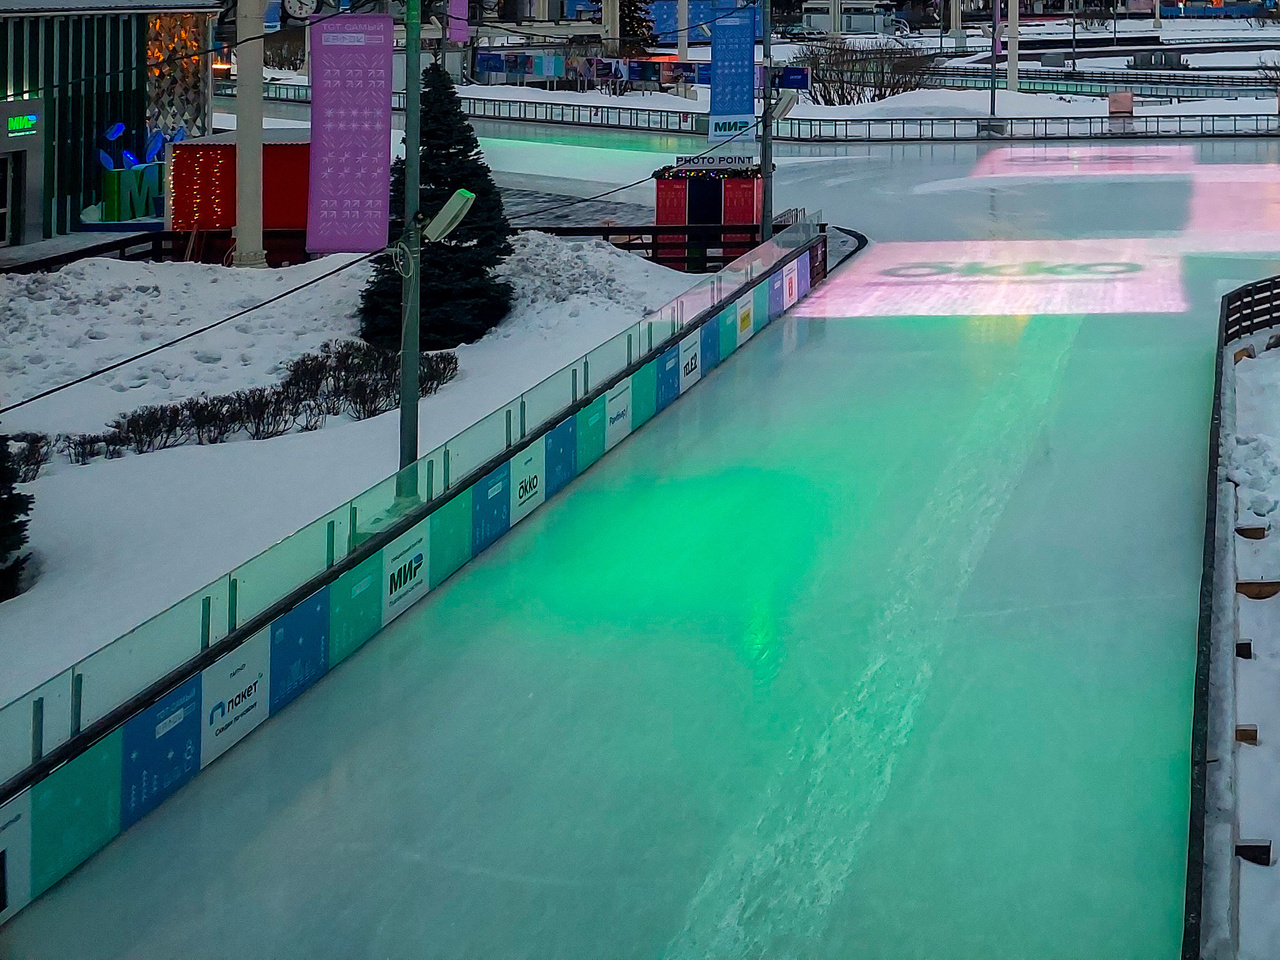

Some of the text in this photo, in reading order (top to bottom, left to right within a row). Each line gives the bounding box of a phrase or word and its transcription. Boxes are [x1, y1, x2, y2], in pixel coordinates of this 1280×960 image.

[322, 23, 383, 31] ТОТ САМЫЙ
[8, 114, 37, 130] МИР
[714, 121, 749, 132] МИР
[676, 156, 753, 165] PHOTO POINT
[389, 553, 424, 596] МИР
[227, 680, 259, 714] пакет
